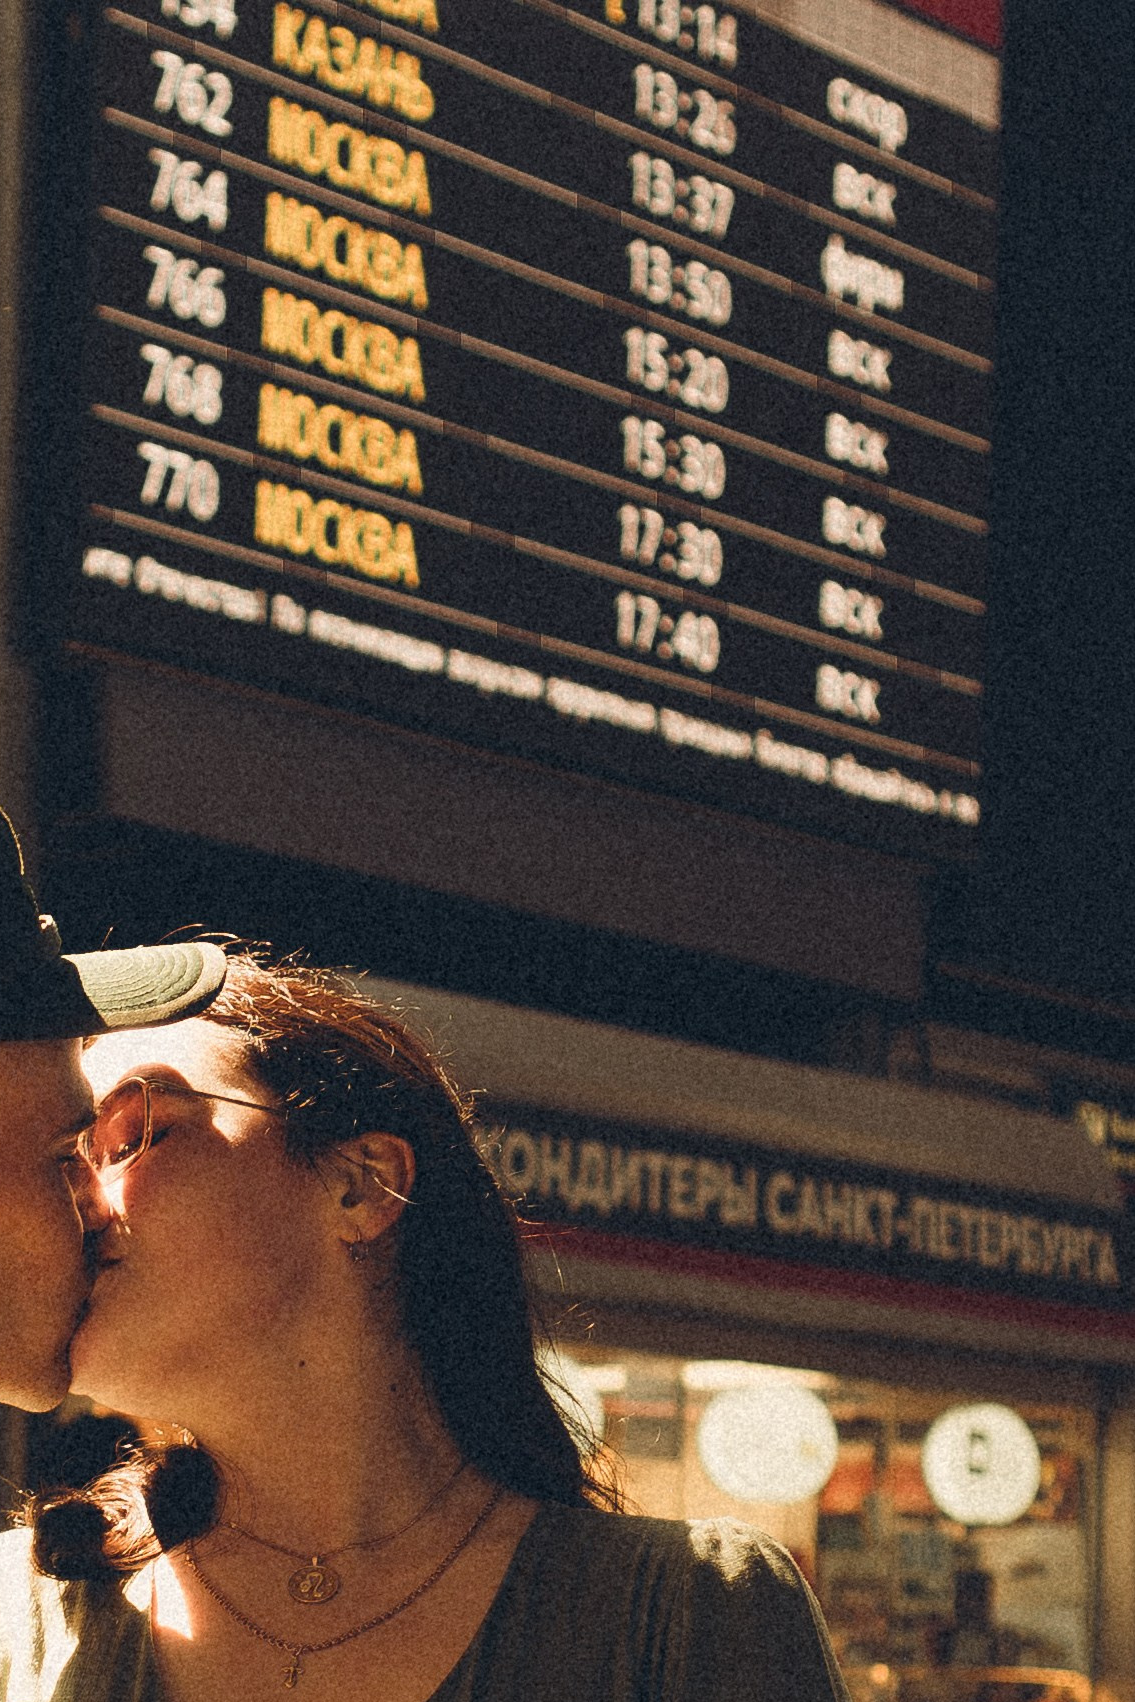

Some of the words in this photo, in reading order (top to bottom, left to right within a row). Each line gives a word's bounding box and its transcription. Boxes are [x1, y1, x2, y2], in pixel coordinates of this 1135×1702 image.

[151, 50, 233, 137] 762
[268, 97, 432, 216] МОСКВА
[627, 239, 732, 326] 13:50
[272, 2, 435, 121] КАЗАНЬ
[629, 152, 735, 238] 13:37
[143, 245, 226, 328] 766
[262, 288, 425, 402] МОСКВА
[621, 416, 726, 499] 15:30
[148, 148, 228, 231] 764
[265, 192, 428, 311] МОСКВА
[623, 327, 729, 413] 15:20
[137, 441, 220, 521] 770
[255, 480, 420, 588] МОСКВА
[615, 591, 720, 673] 17:40
[140, 343, 223, 424] 768
[258, 383, 423, 494] МОСКВА
[619, 504, 723, 586] 17:30
[766, 1172, 1119, 1287] САНКТ-ПЕТЕРБУРГА
